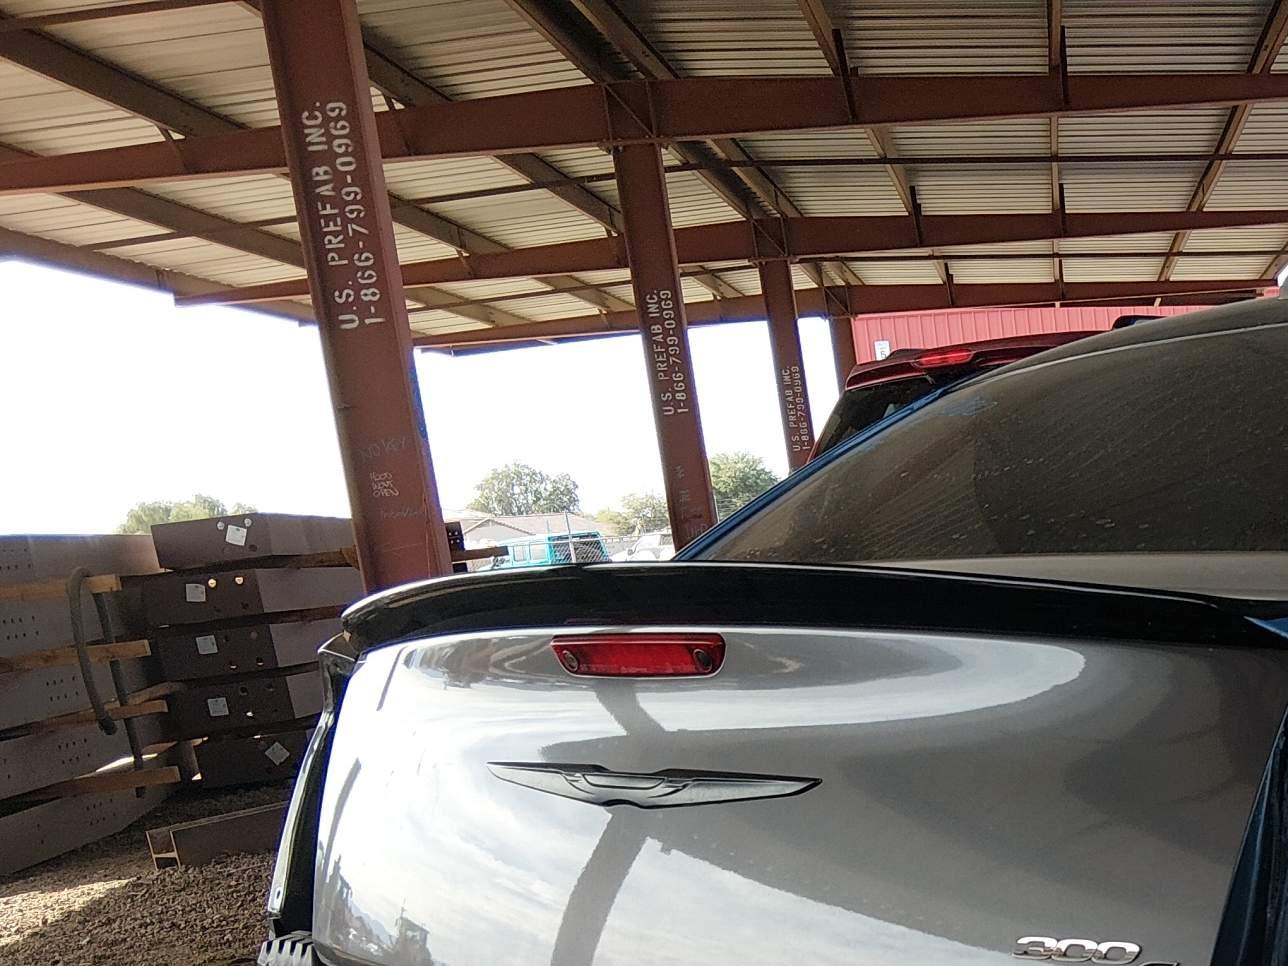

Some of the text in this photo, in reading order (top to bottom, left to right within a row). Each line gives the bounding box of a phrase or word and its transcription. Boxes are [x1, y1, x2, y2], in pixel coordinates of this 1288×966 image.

[301, 101, 360, 330] U.S. PREFAB INC.
[326, 101, 386, 326] 1-866-799-0969
[646, 289, 675, 415] U.S. PREFAB INC.
[660, 290, 689, 413] 1-866-799-0969
[784, 389, 799, 428] PREFAB
[1012, 936, 1142, 965] 300
